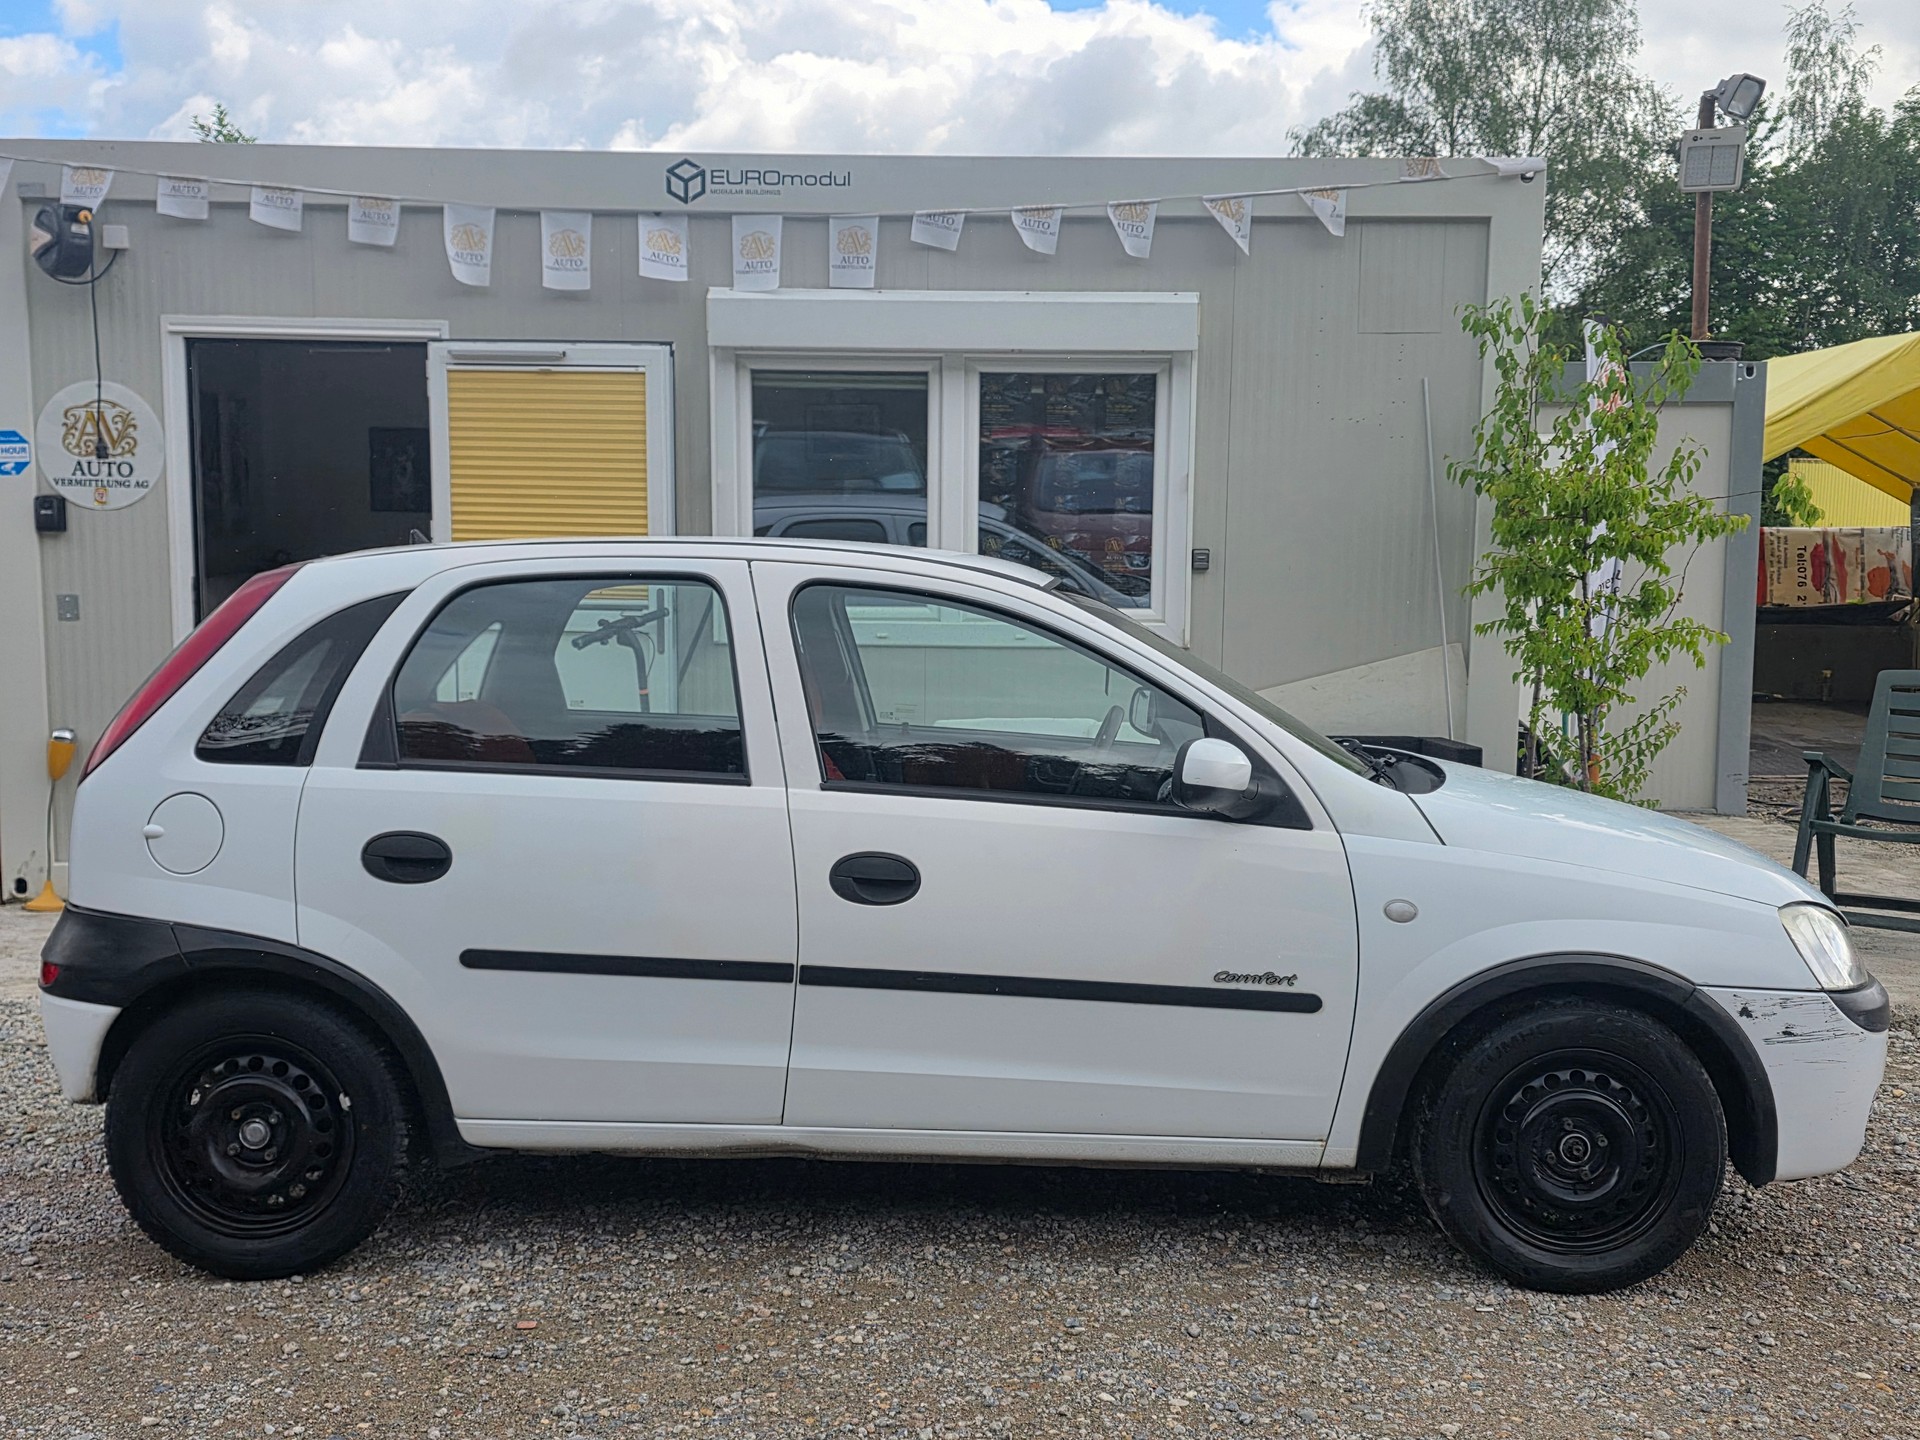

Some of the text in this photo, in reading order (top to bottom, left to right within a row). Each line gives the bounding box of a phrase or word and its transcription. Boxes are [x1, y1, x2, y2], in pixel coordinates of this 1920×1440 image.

[711, 169, 851, 187] EUROmodul
[263, 195, 295, 206] AUTO
[360, 211, 392, 221] AUTO
[1021, 218, 1051, 231] AUTO
[454, 251, 484, 262] AUTO
[650, 251, 680, 264] AUTO
[840, 255, 870, 265] AUTO
[553, 258, 584, 267] AUTO
[743, 260, 773, 270] AUTO
[71, 461, 134, 479] AUTO
[53, 477, 149, 489] VERMITTLUNG AG
[1213, 970, 1298, 987] Comfort
